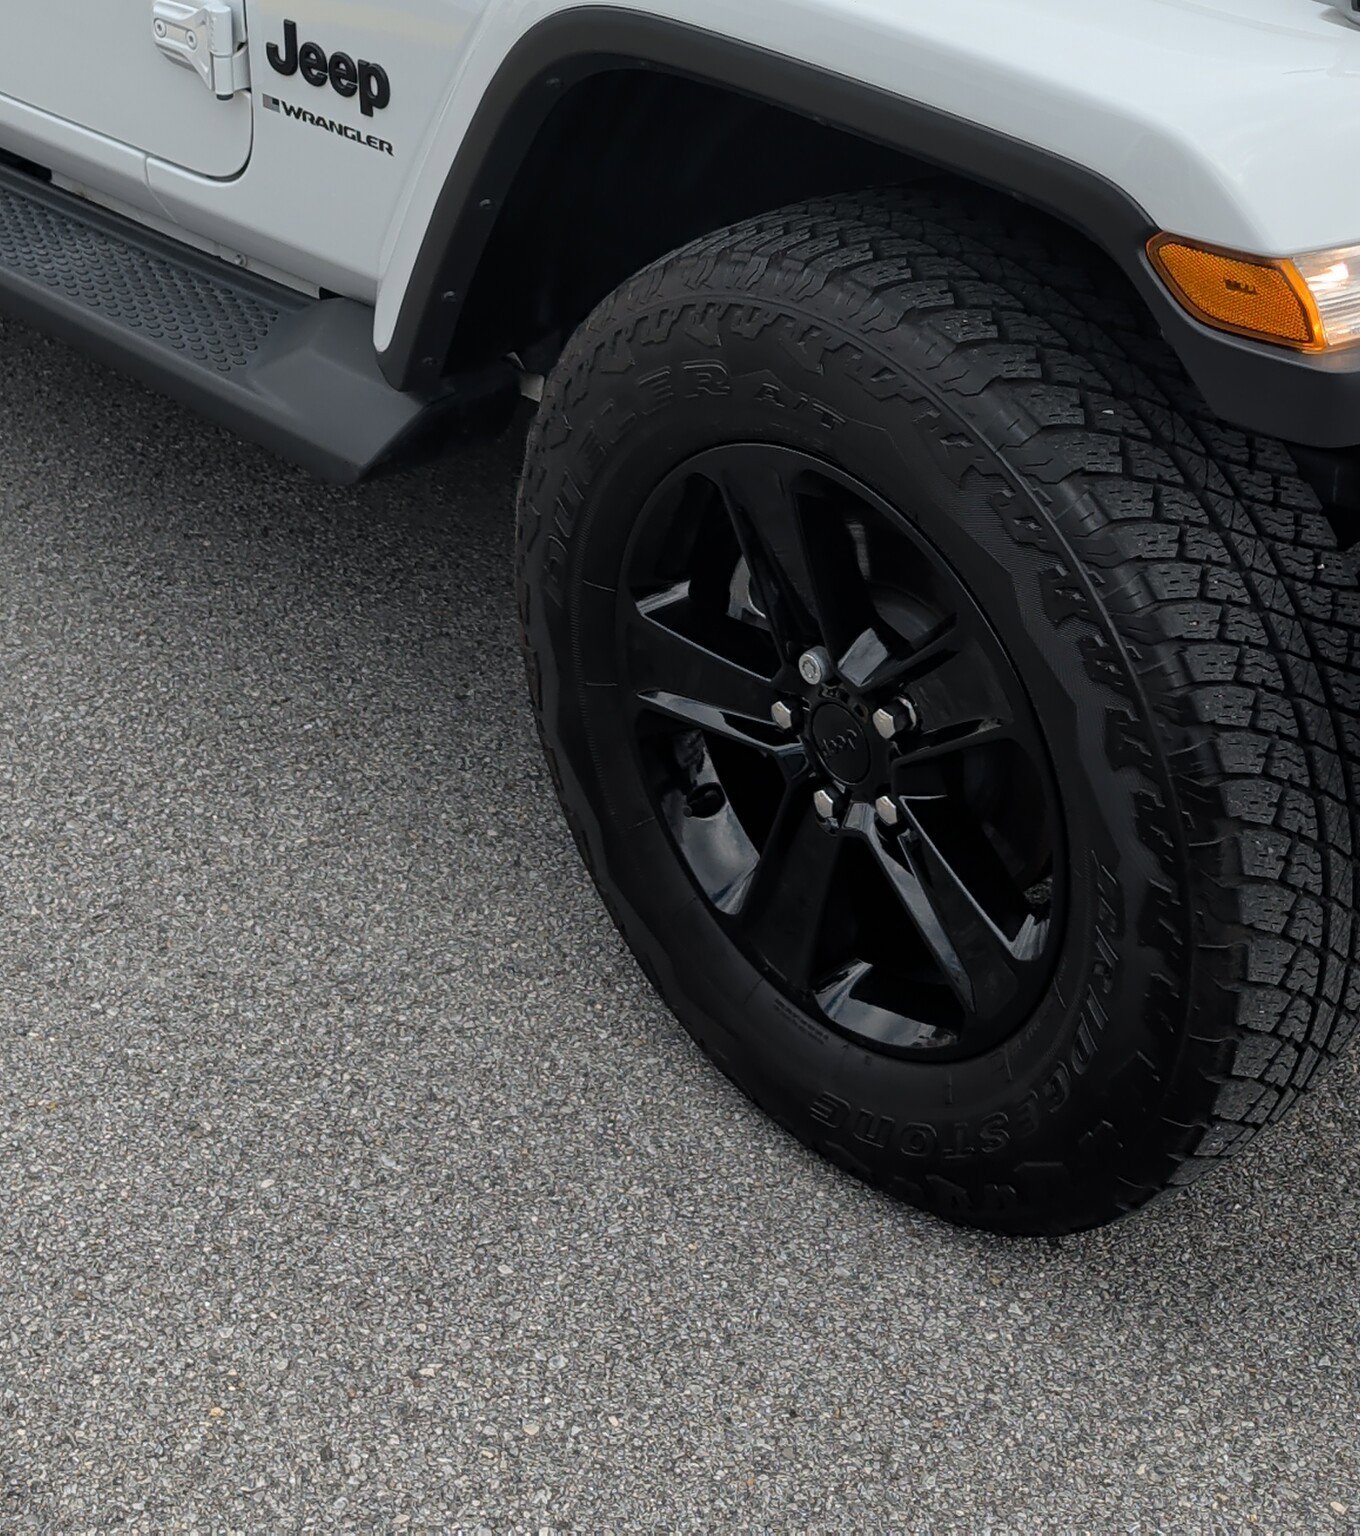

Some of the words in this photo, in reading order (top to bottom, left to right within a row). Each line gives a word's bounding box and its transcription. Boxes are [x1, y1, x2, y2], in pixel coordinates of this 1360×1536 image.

[265, 18, 391, 118] Jeep
[280, 100, 395, 157] WRANGLER
[808, 848, 1121, 1160] BRIDGESTONE
